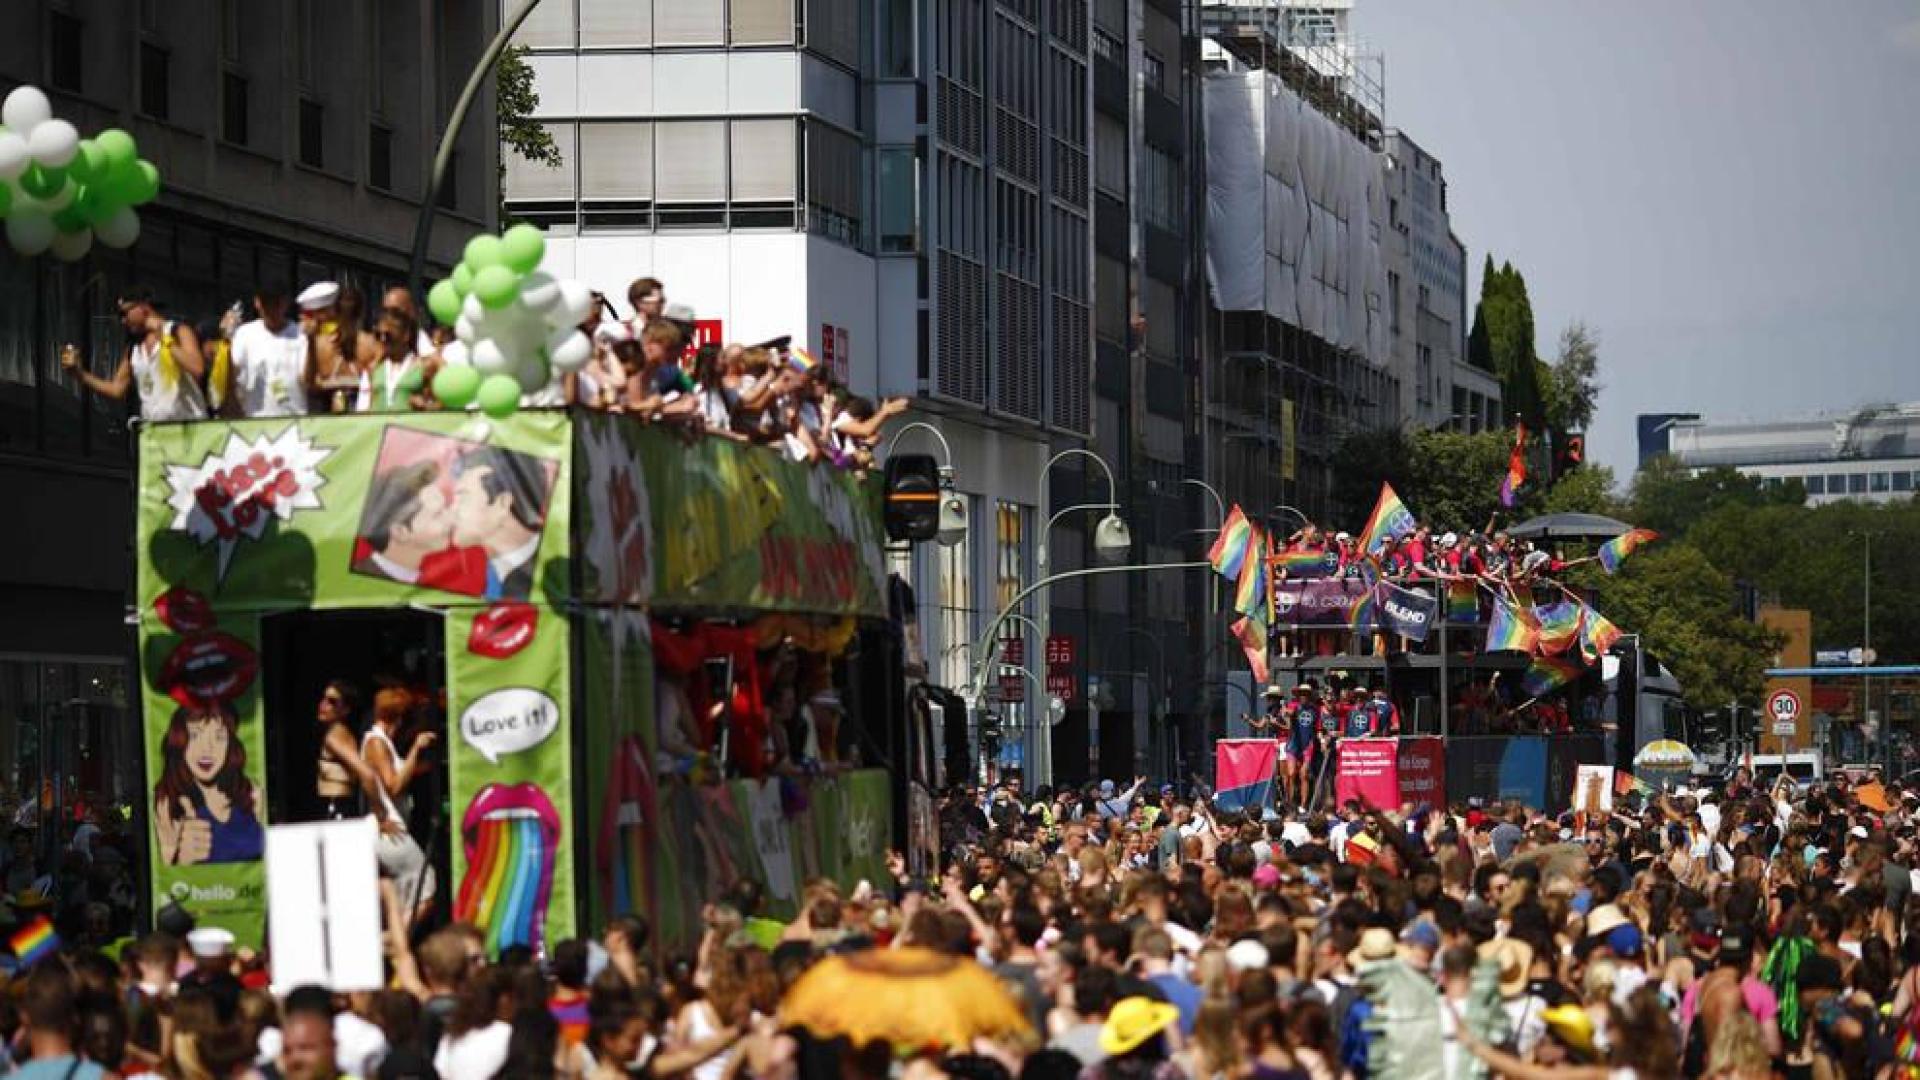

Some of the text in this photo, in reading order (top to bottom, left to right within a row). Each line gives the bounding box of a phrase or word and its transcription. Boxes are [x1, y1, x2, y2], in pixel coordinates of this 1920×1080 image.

[1384, 600, 1426, 623] BLEND
[1775, 699, 1793, 714] 30
[469, 716, 519, 736] Love
